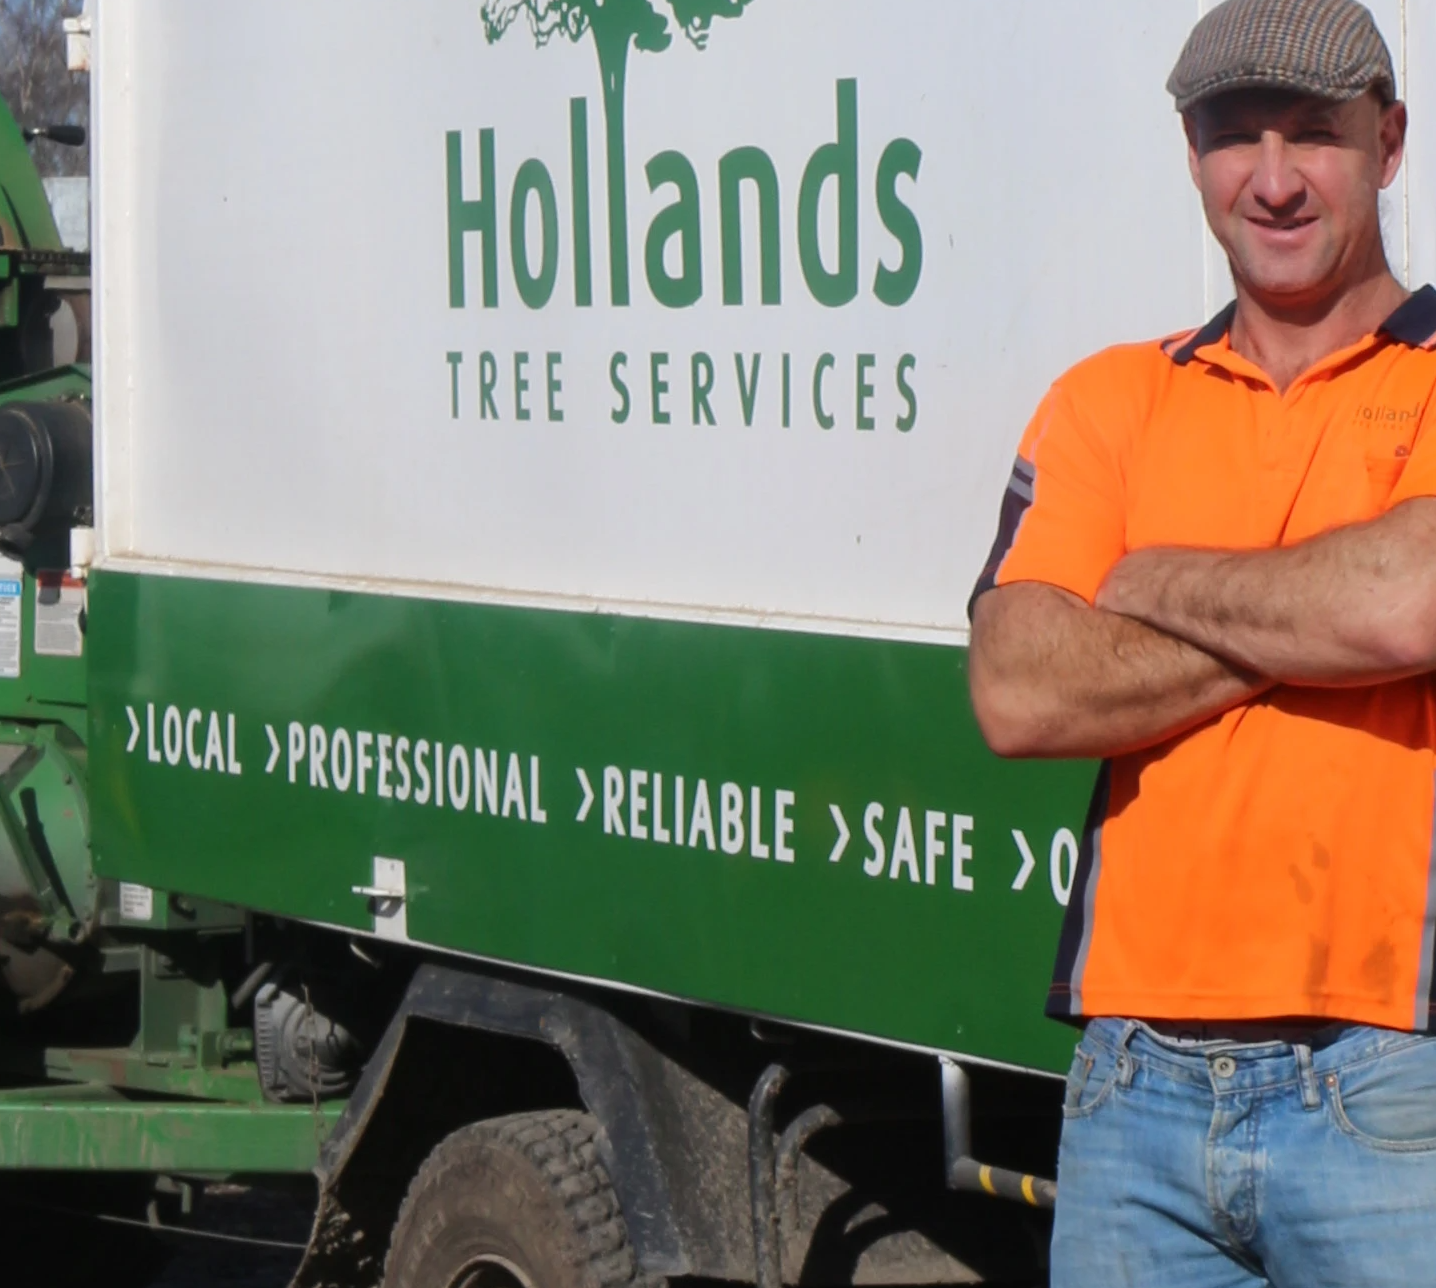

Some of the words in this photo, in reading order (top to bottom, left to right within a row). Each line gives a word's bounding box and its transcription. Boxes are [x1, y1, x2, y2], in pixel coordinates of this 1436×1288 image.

[446, 77, 923, 308] Hollands
[446, 350, 565, 423] TREE
[609, 350, 918, 434] SERVICES
